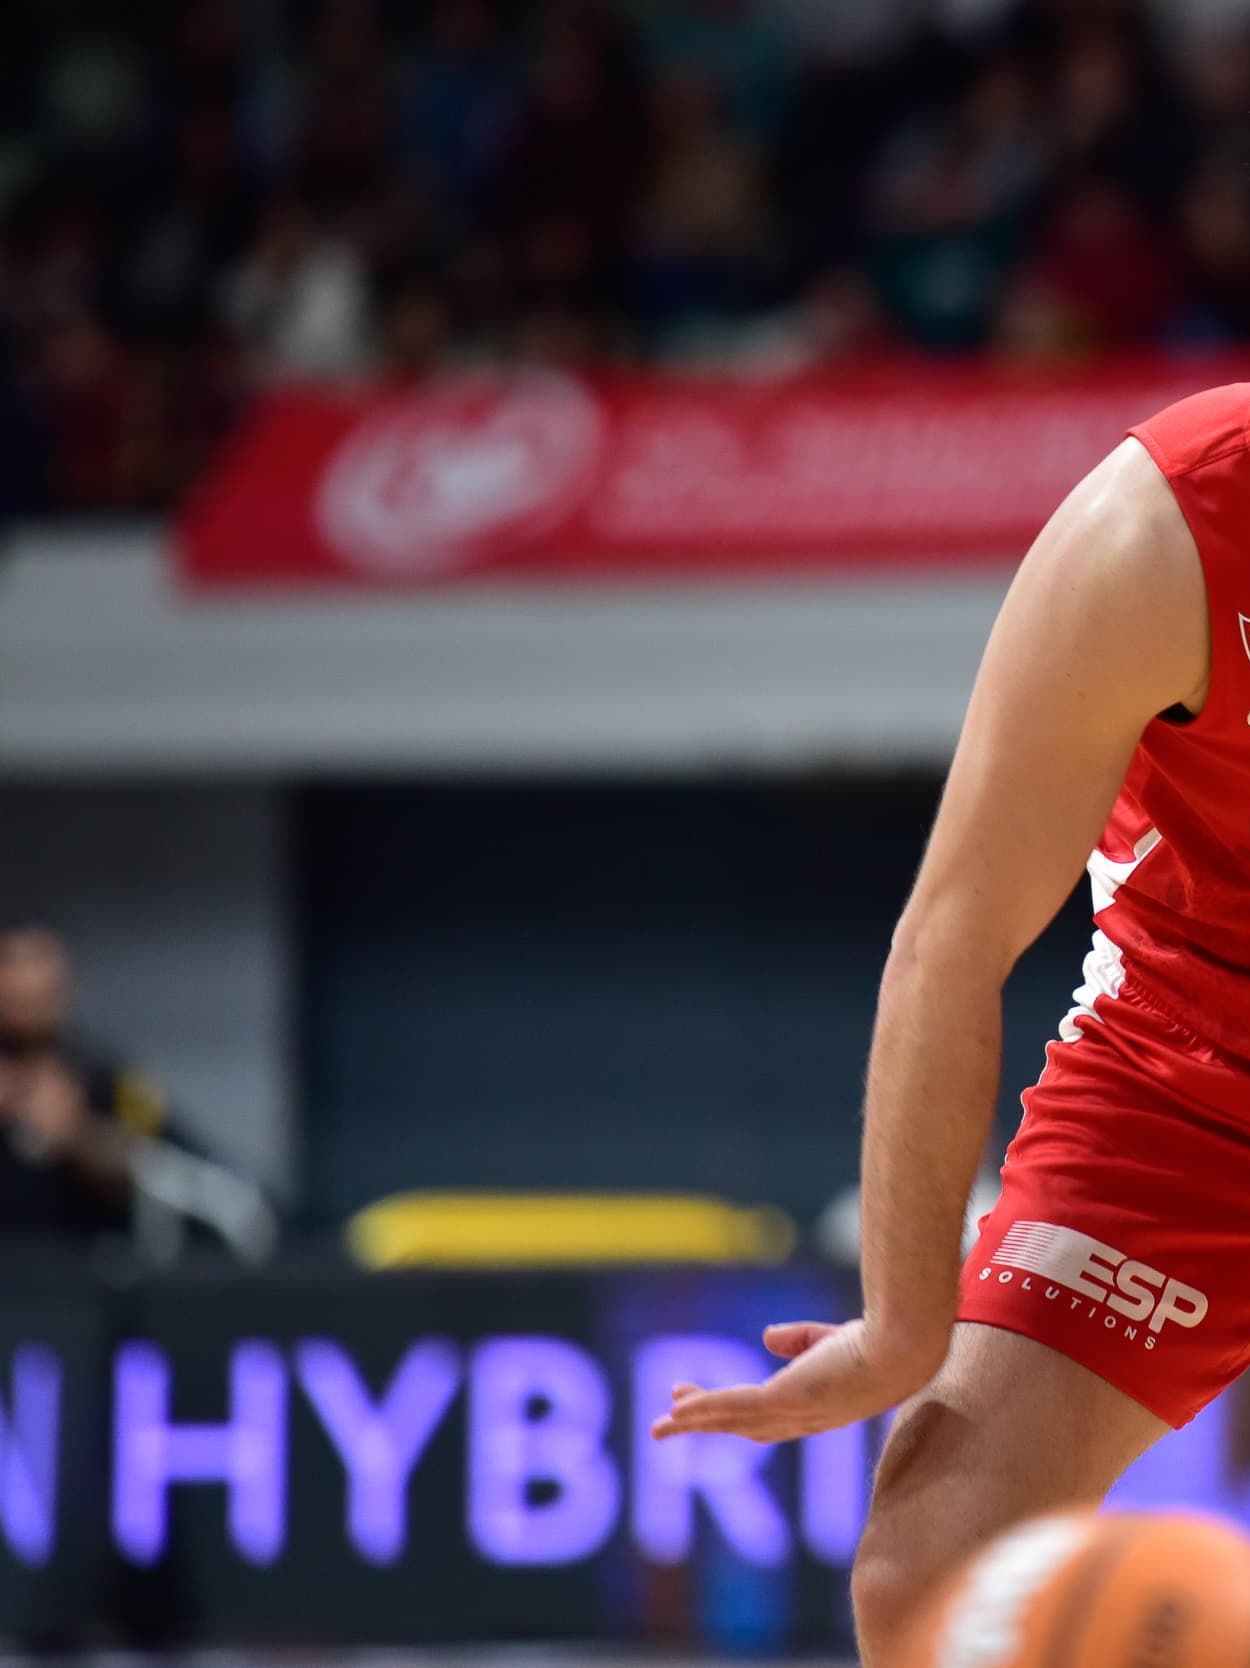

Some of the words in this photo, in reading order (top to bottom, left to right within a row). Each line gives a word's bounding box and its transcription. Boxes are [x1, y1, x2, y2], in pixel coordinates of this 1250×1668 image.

[979, 1267, 1156, 1350] SOLUTIONS
[1058, 1230, 1209, 1334] ESP
[110, 1335, 900, 1569] HYBRI
